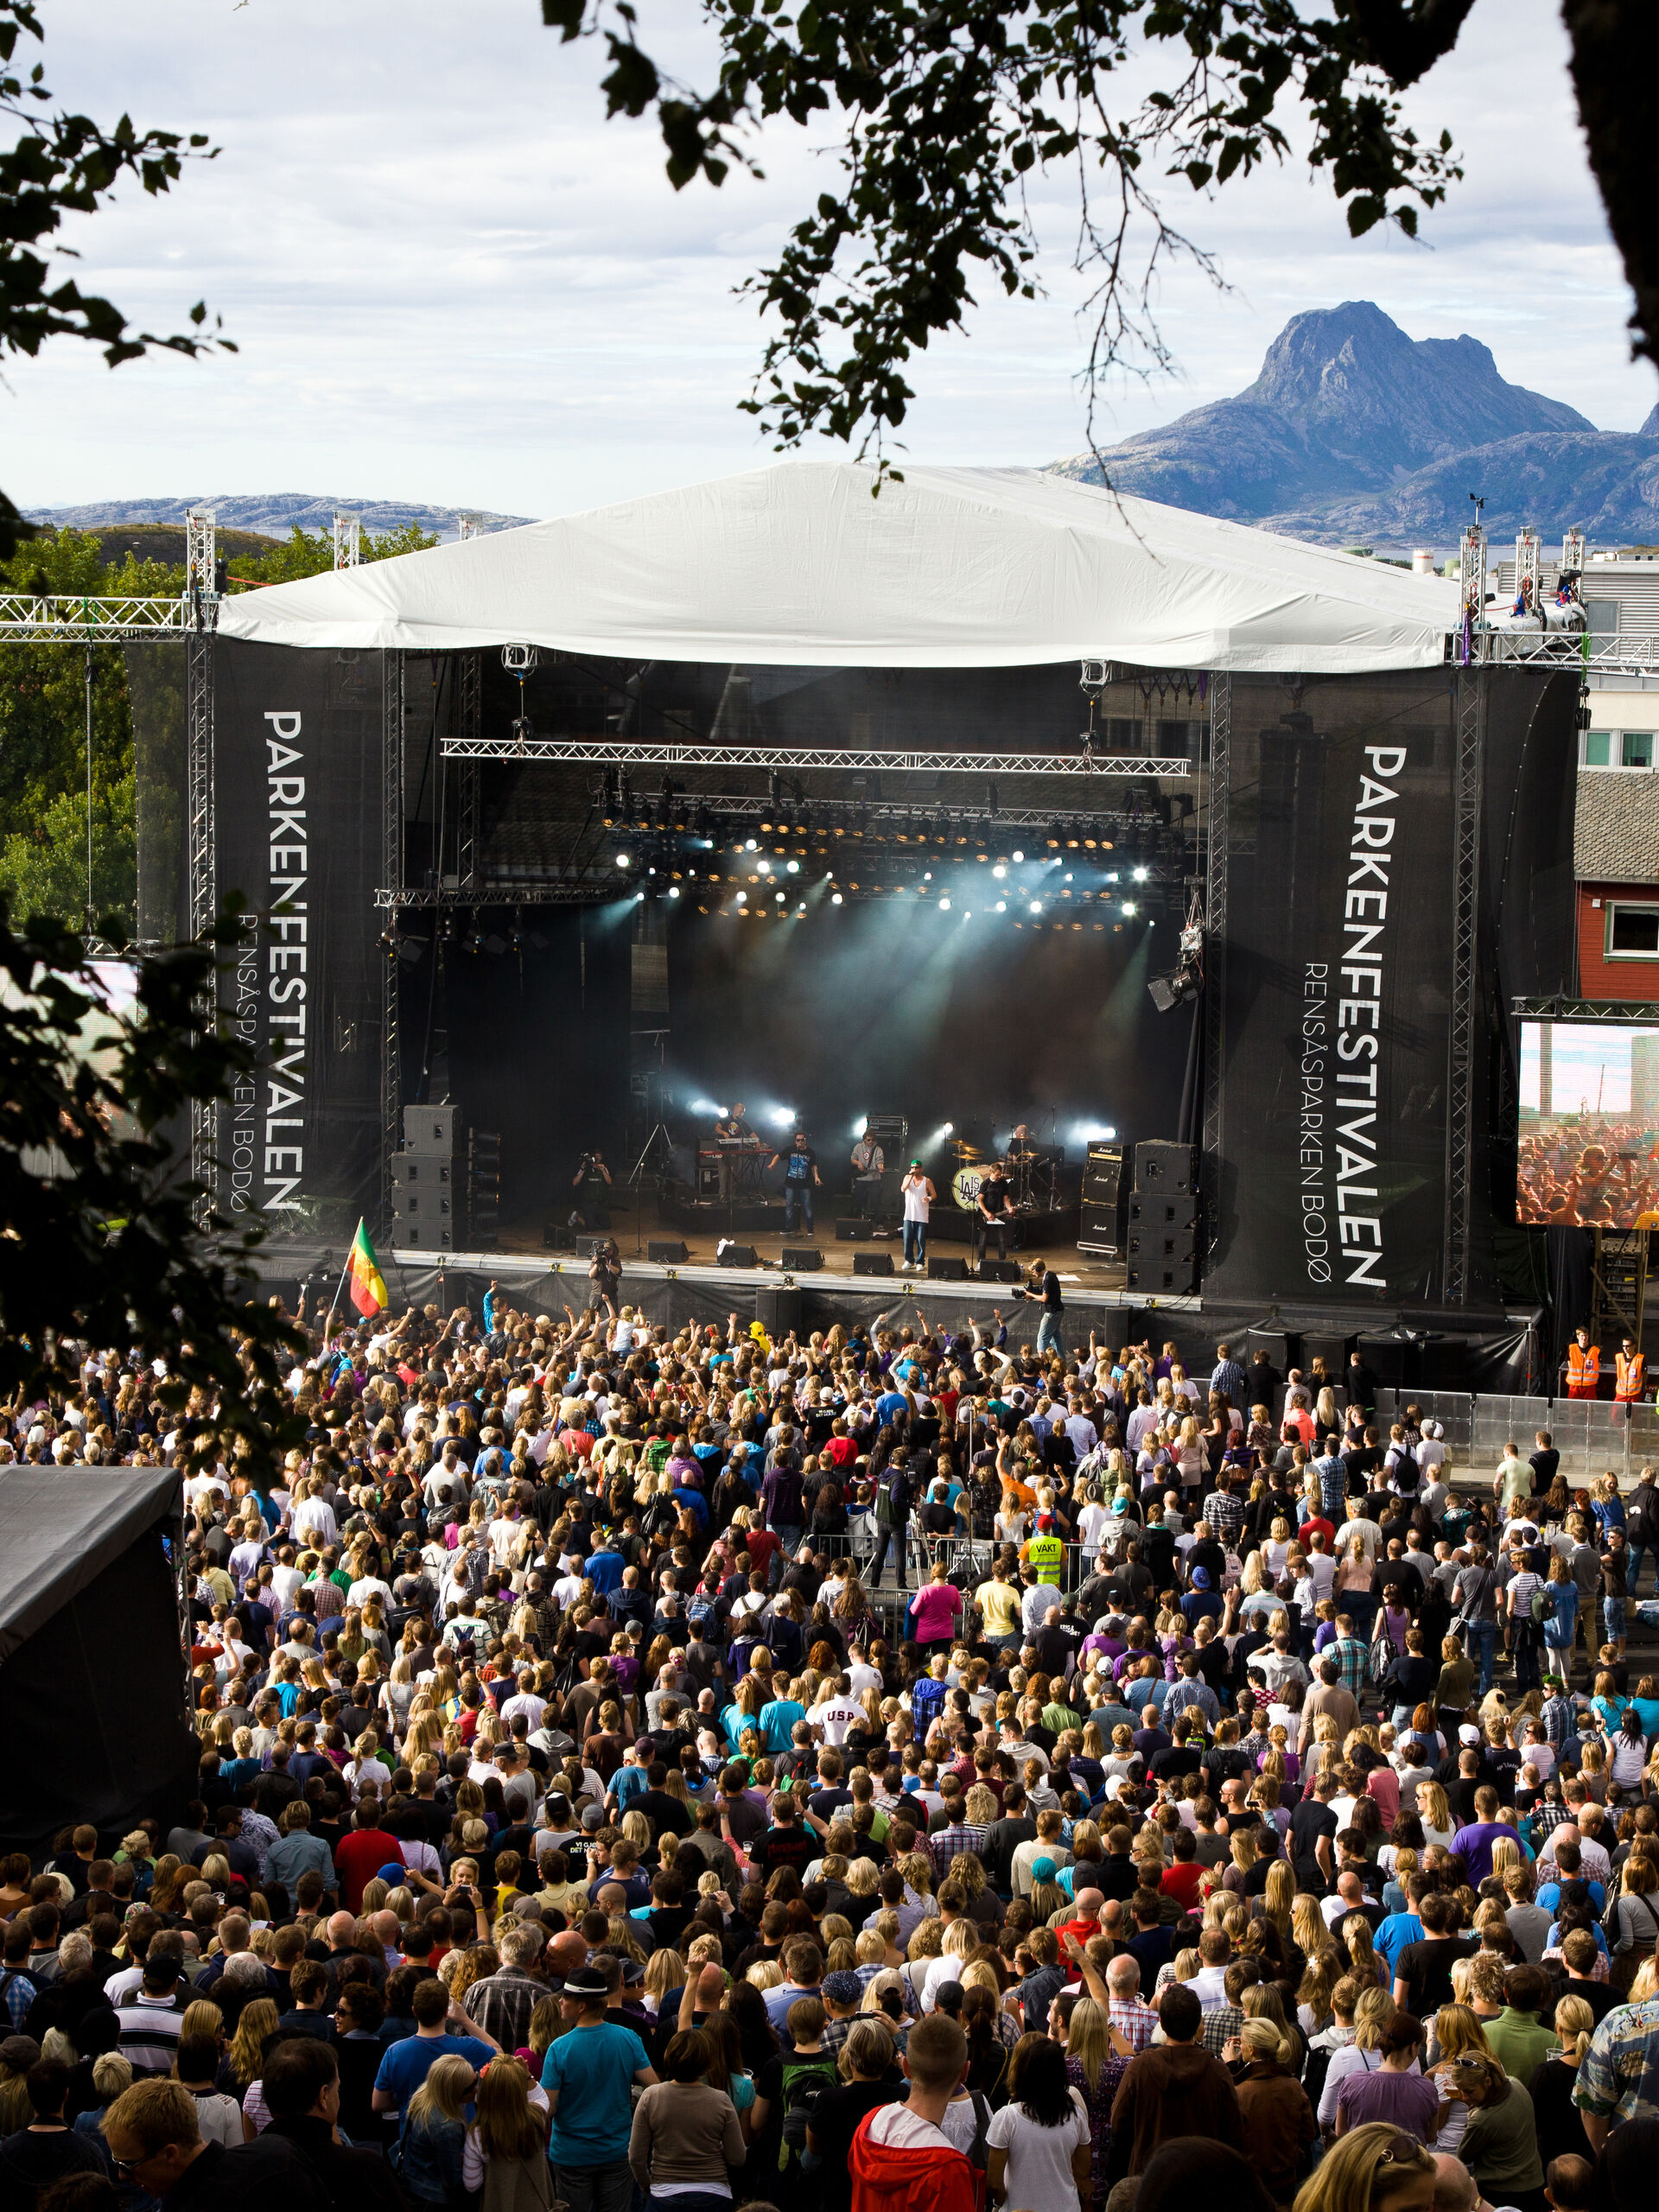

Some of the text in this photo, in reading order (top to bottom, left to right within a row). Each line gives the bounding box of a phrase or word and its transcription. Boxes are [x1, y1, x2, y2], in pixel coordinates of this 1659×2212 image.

[230, 914, 261, 1212] RENSÅSPAKEN BODØ
[263, 712, 308, 1210] PARKENFESTIVALEN
[1336, 746, 1408, 1287] PARKENFESTIVALEN
[1300, 963, 1332, 1283] RENSÅSPARKEN BODØ
[1036, 1544, 1057, 1553] VAKT
[827, 1710, 855, 1722] USA
